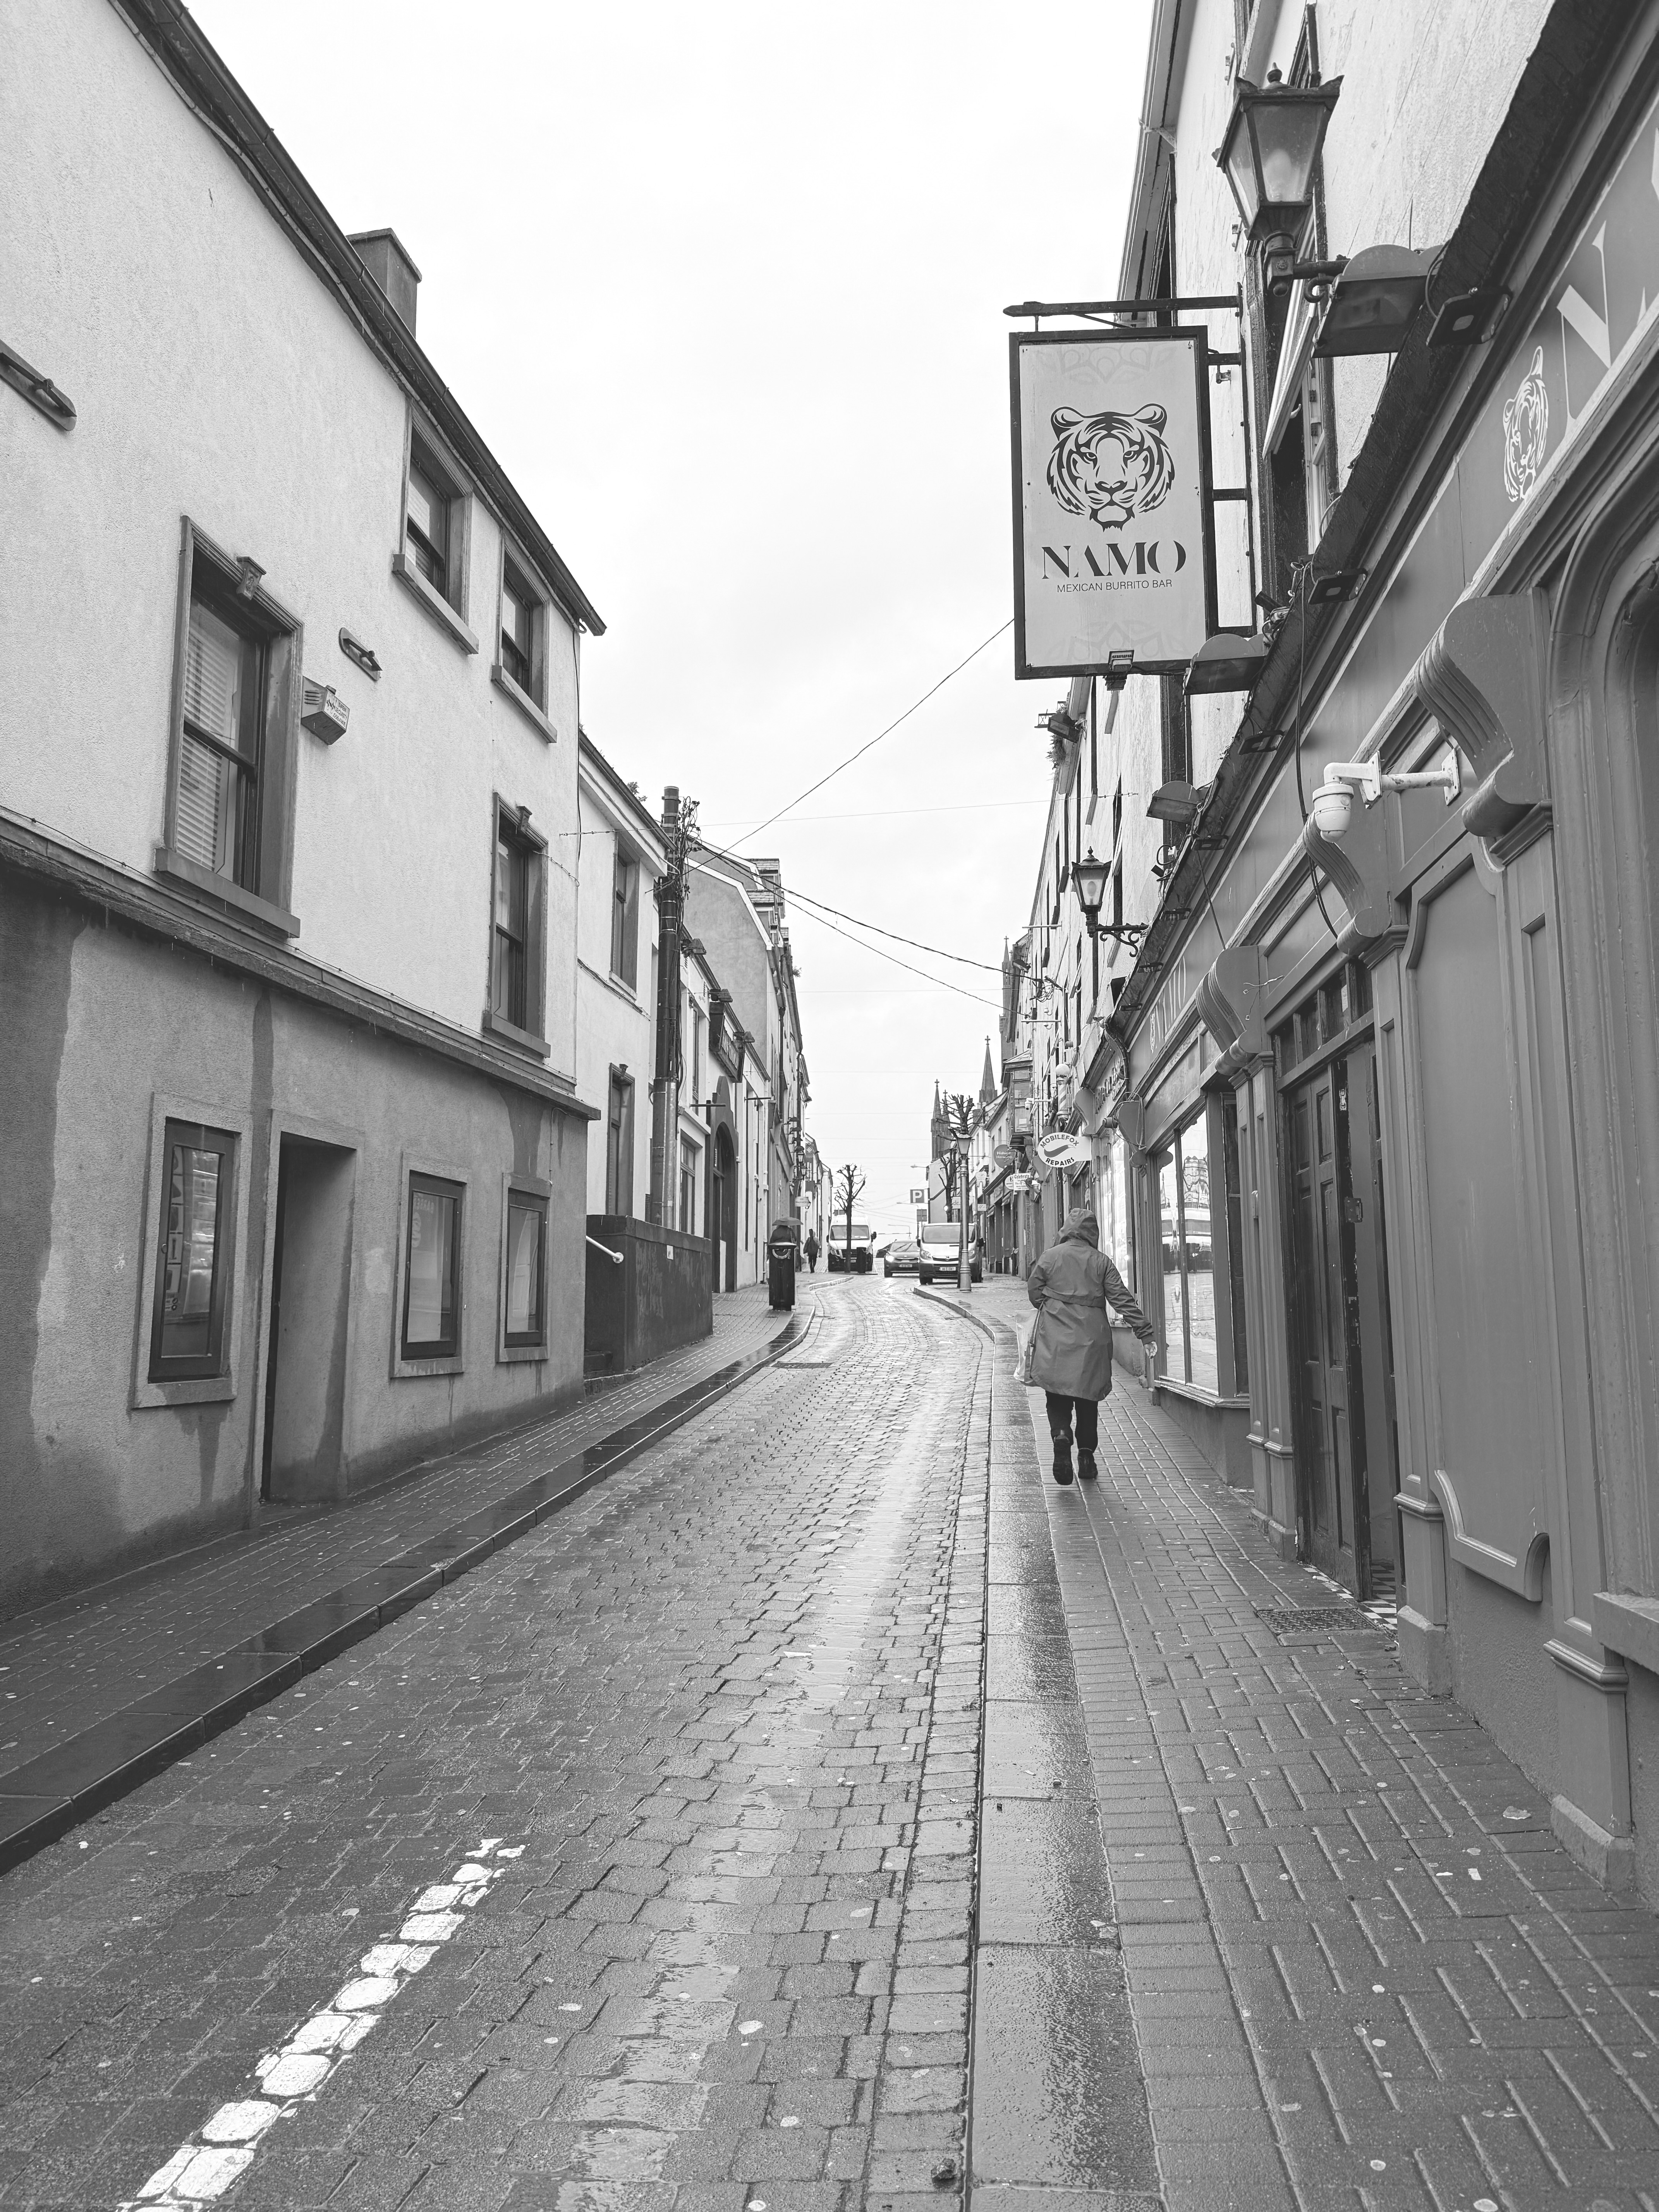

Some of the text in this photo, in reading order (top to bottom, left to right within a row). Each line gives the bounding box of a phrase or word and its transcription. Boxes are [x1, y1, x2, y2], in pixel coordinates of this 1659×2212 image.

[1042, 541, 1186, 579] NAMO
[1057, 579, 1172, 593] MEXICAN BURRITO BAR
[1040, 1134, 1079, 1148] MOBILEFOX
[1046, 1157, 1074, 1166] REPAIRS
[912, 1190, 922, 1203] P
